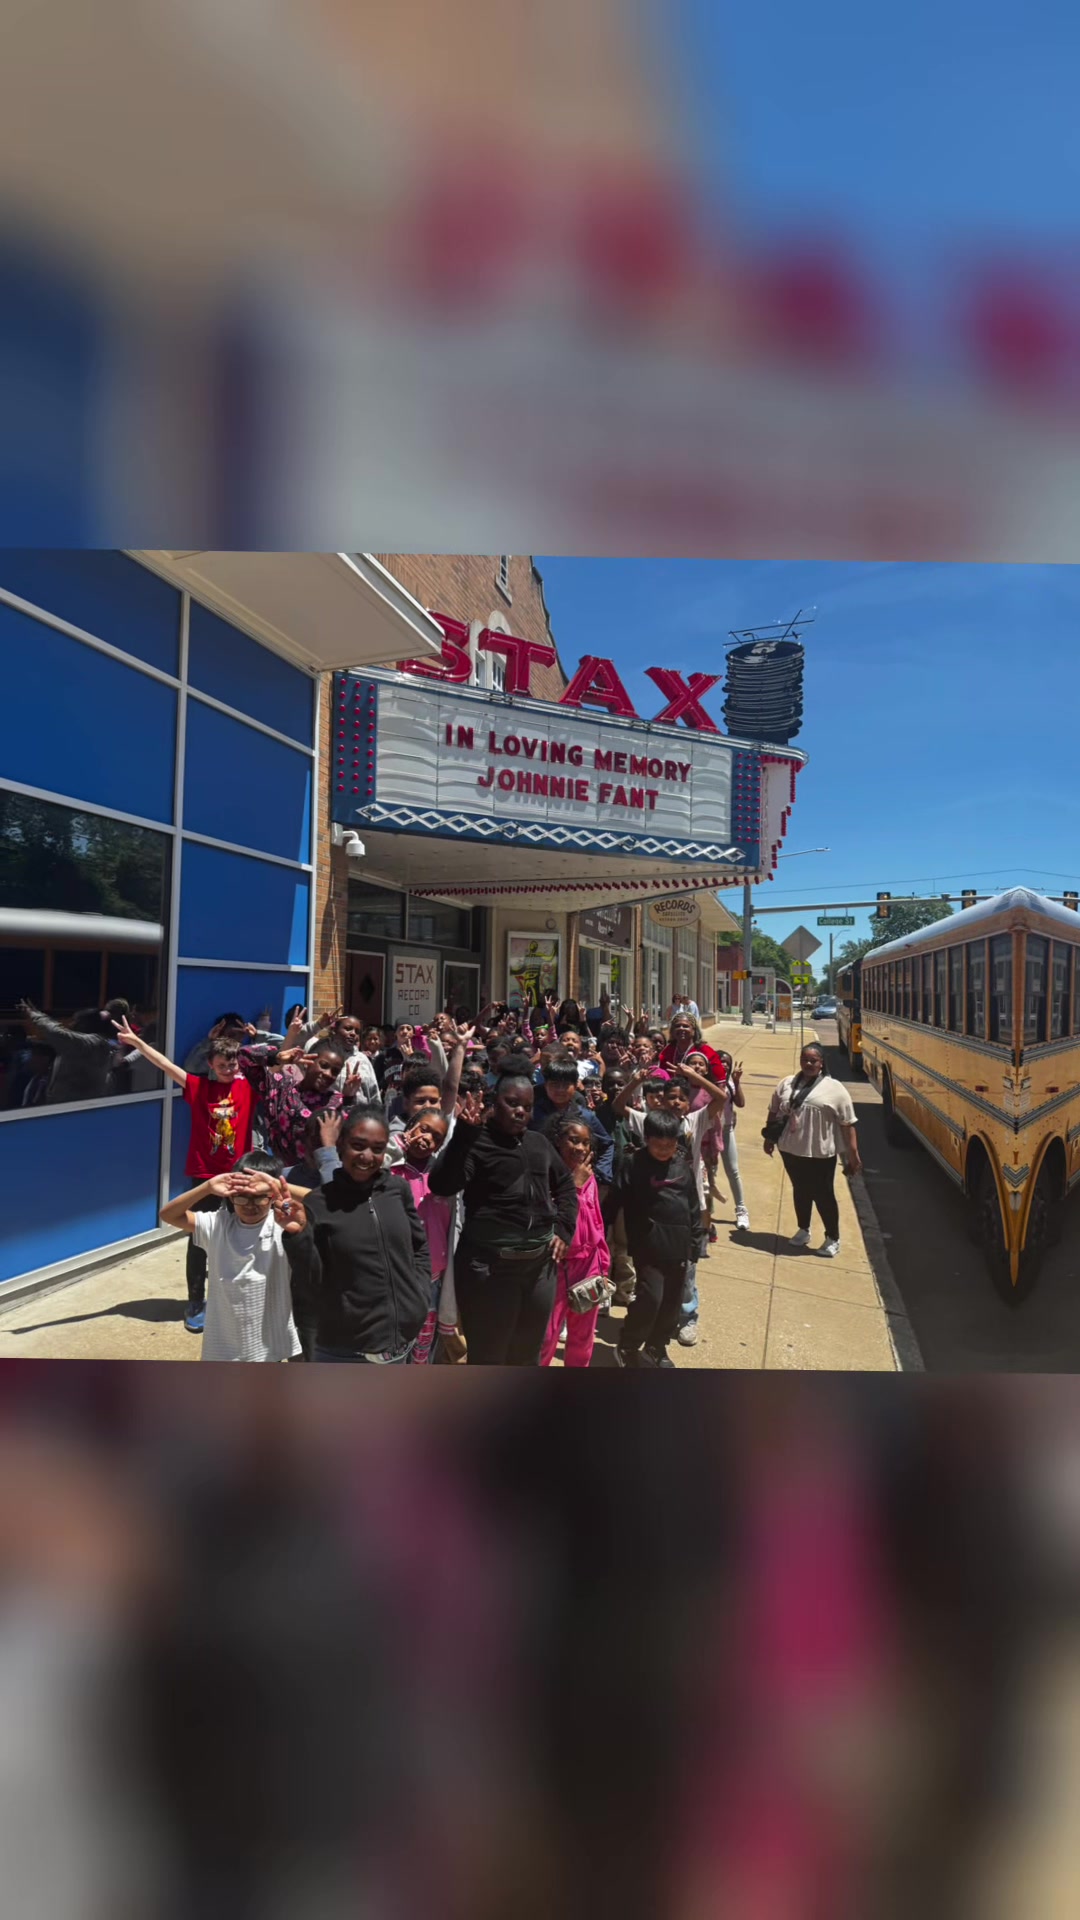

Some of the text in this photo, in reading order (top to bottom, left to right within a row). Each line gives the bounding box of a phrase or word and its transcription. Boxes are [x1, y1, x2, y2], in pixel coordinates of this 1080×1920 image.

[396, 608, 723, 735] STAX
[446, 723, 692, 783] IN LOVING MEMORY
[477, 766, 659, 810] JOHNNIE FANT
[653, 899, 696, 914] RECORDS
[395, 962, 434, 984] STAX
[397, 989, 430, 1001] RECORD
